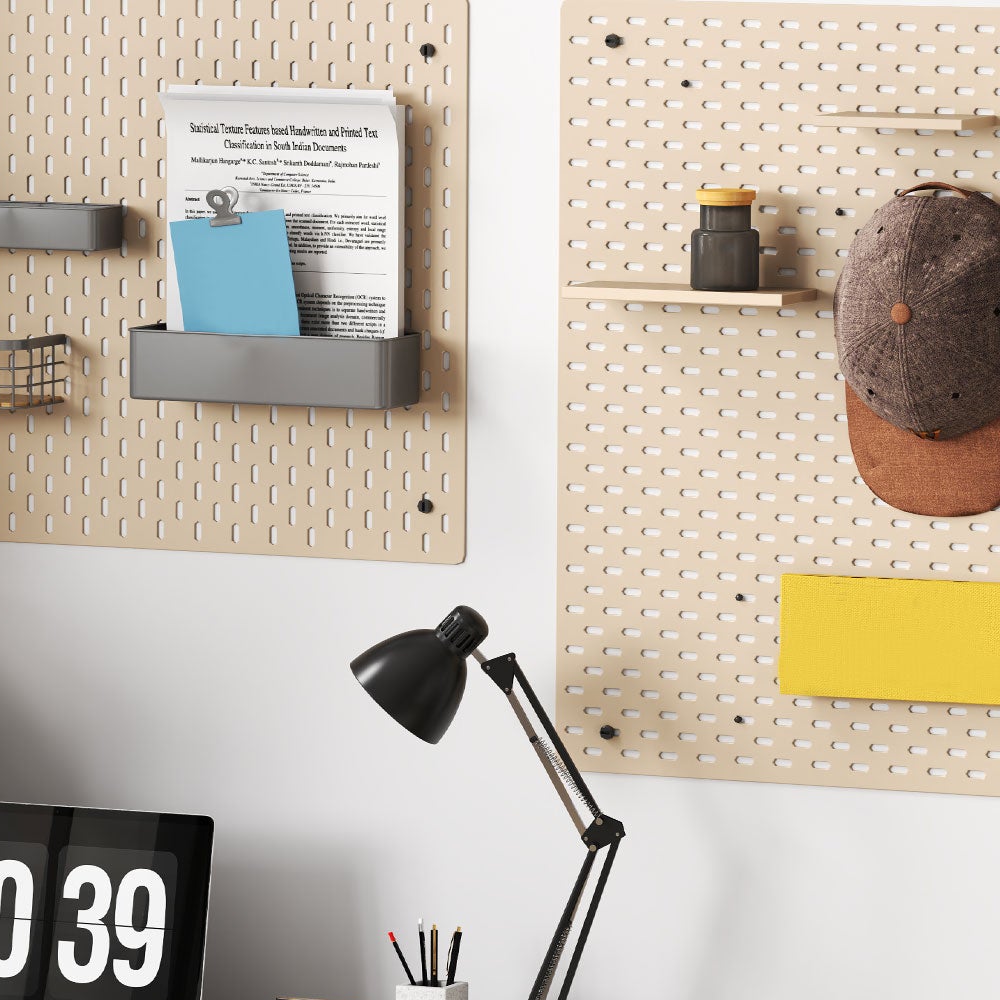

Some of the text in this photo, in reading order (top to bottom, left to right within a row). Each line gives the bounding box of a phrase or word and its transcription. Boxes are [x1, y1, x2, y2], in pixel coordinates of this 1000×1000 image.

[190, 122, 378, 138] Statistical Texture Features based Handwritten and Printed Text
[224, 139, 347, 152] Classification in South Indian Documents
[56, 864, 168, 988] 39
